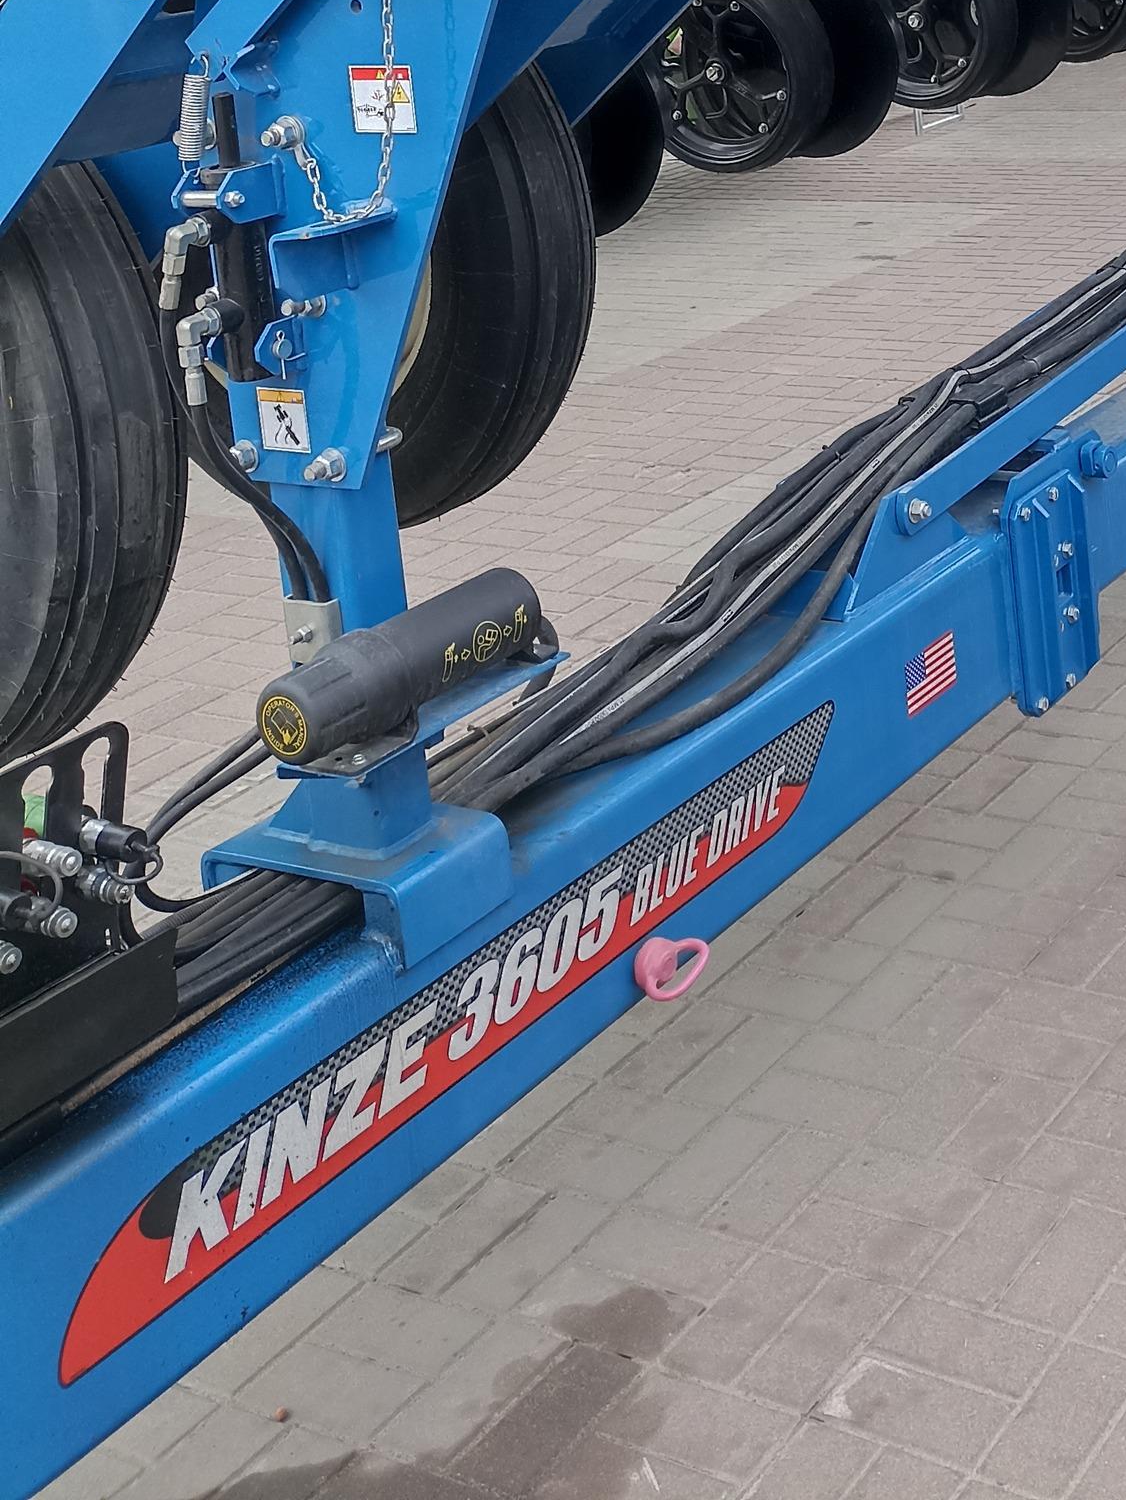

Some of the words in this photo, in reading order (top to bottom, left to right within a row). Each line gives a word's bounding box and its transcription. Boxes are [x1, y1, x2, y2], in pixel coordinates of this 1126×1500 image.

[164, 1000, 437, 1282] KINZE
[447, 865, 623, 1061] 3605
[630, 823, 705, 927] BLUE
[706, 765, 786, 869] DRIVE
